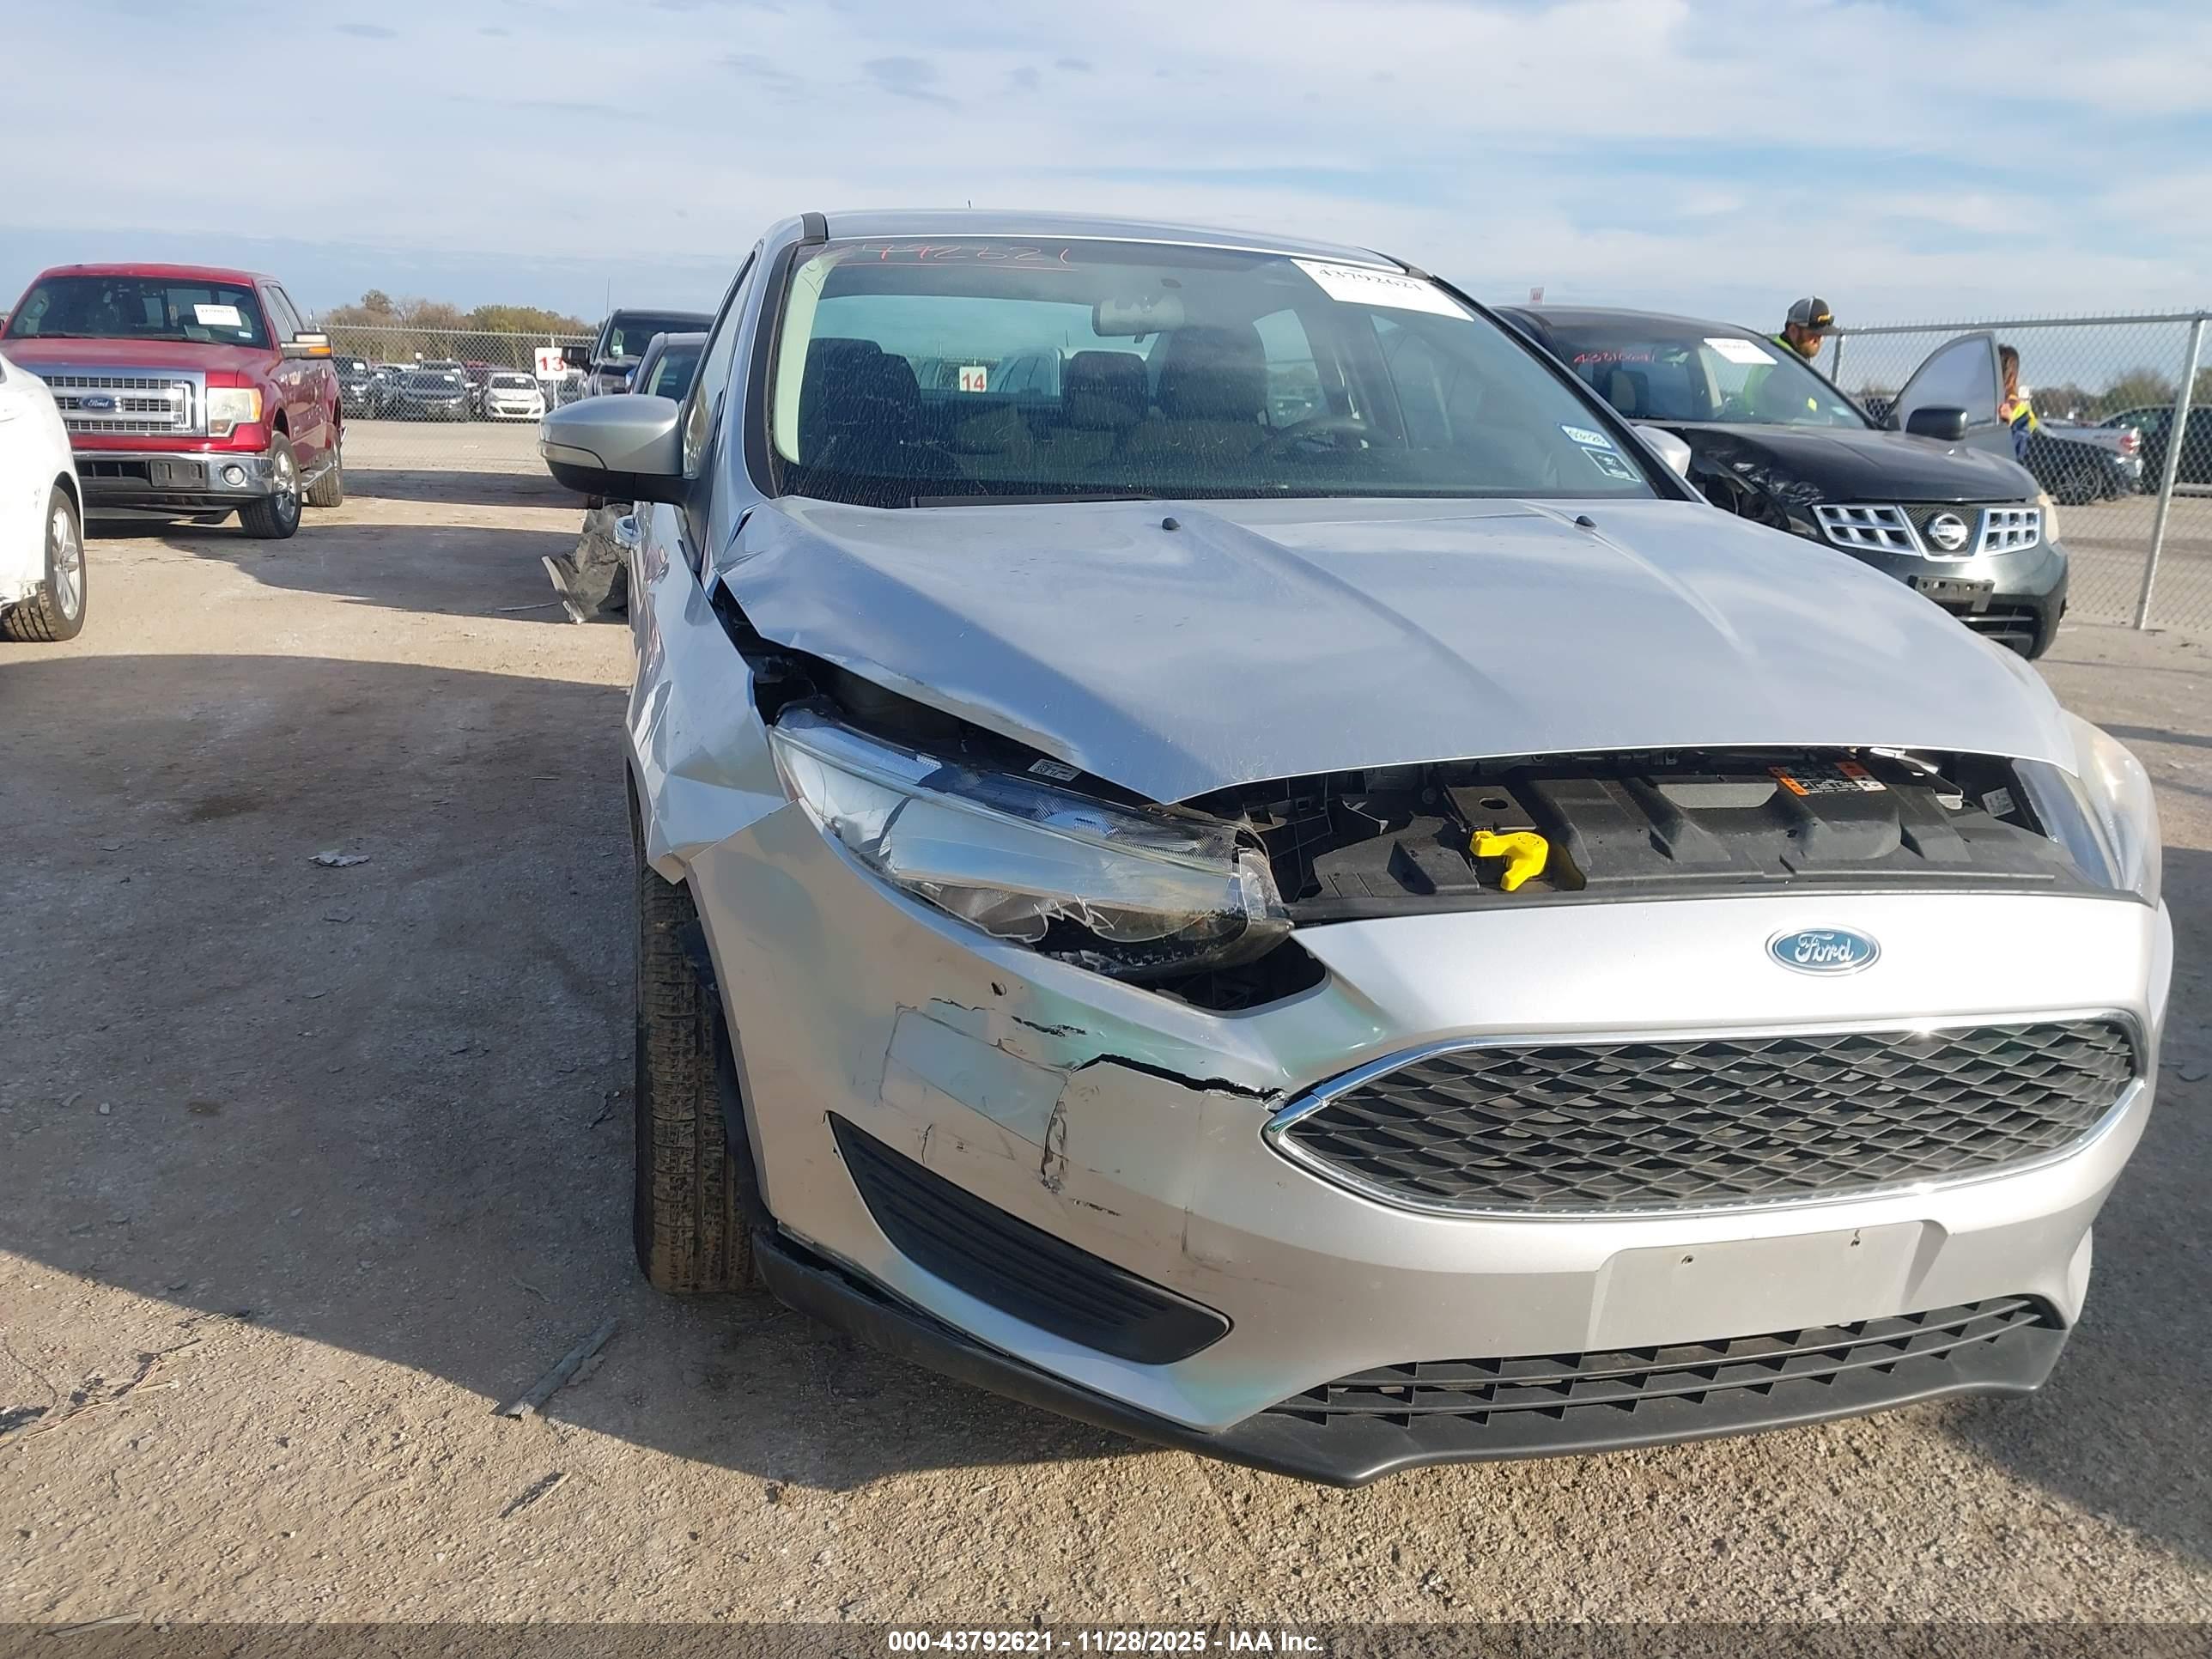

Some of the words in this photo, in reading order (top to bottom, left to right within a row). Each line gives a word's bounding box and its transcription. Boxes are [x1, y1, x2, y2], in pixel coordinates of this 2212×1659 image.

[538, 356, 564, 371] 13
[962, 373, 985, 392] 14
[88, 398, 110, 407] Ford
[1795, 933, 1853, 963] Ford
